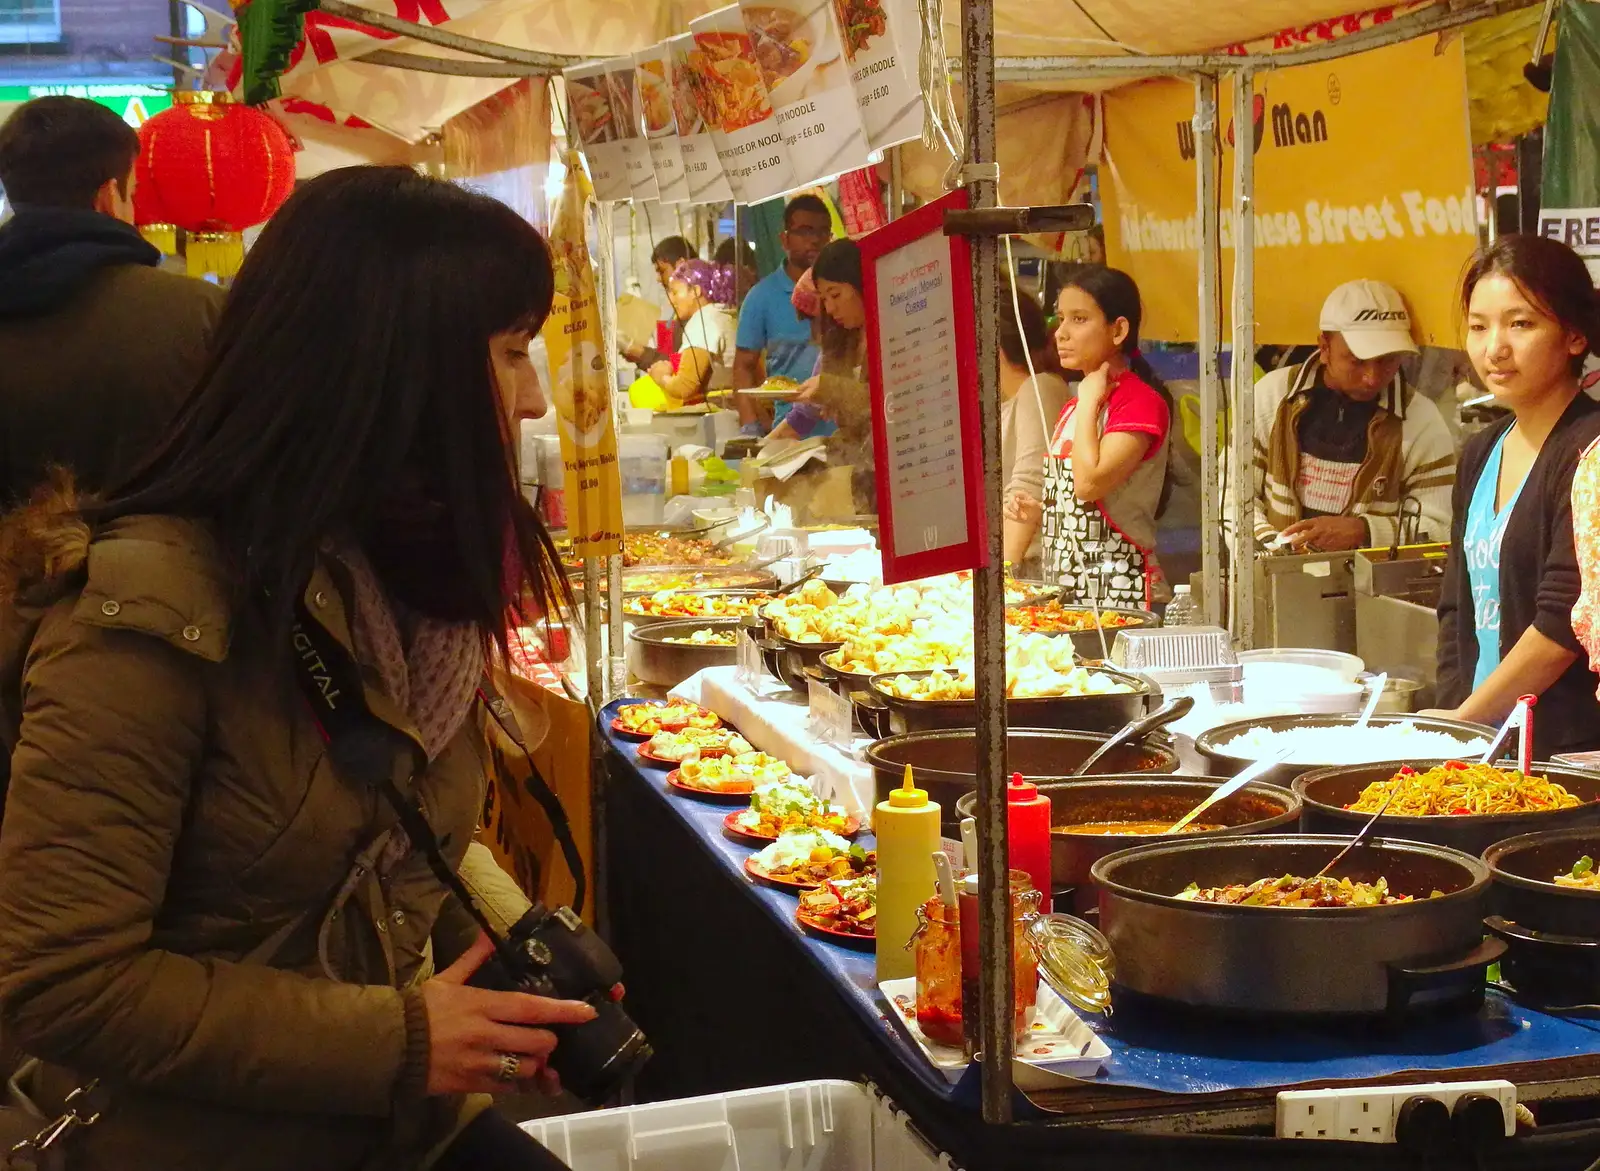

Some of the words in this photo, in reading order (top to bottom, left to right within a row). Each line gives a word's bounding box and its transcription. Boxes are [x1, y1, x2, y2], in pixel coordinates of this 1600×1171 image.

[870, 56, 896, 76] NOODLE
[873, 84, 889, 100] £6.00
[785, 101, 816, 121] NOODLE
[803, 122, 825, 139] £6.00
[1272, 102, 1328, 148] Man
[745, 141, 757, 152] OR
[758, 155, 781, 171] £6.00
[1304, 196, 1403, 246] Street
[1401, 184, 1476, 237] Food
